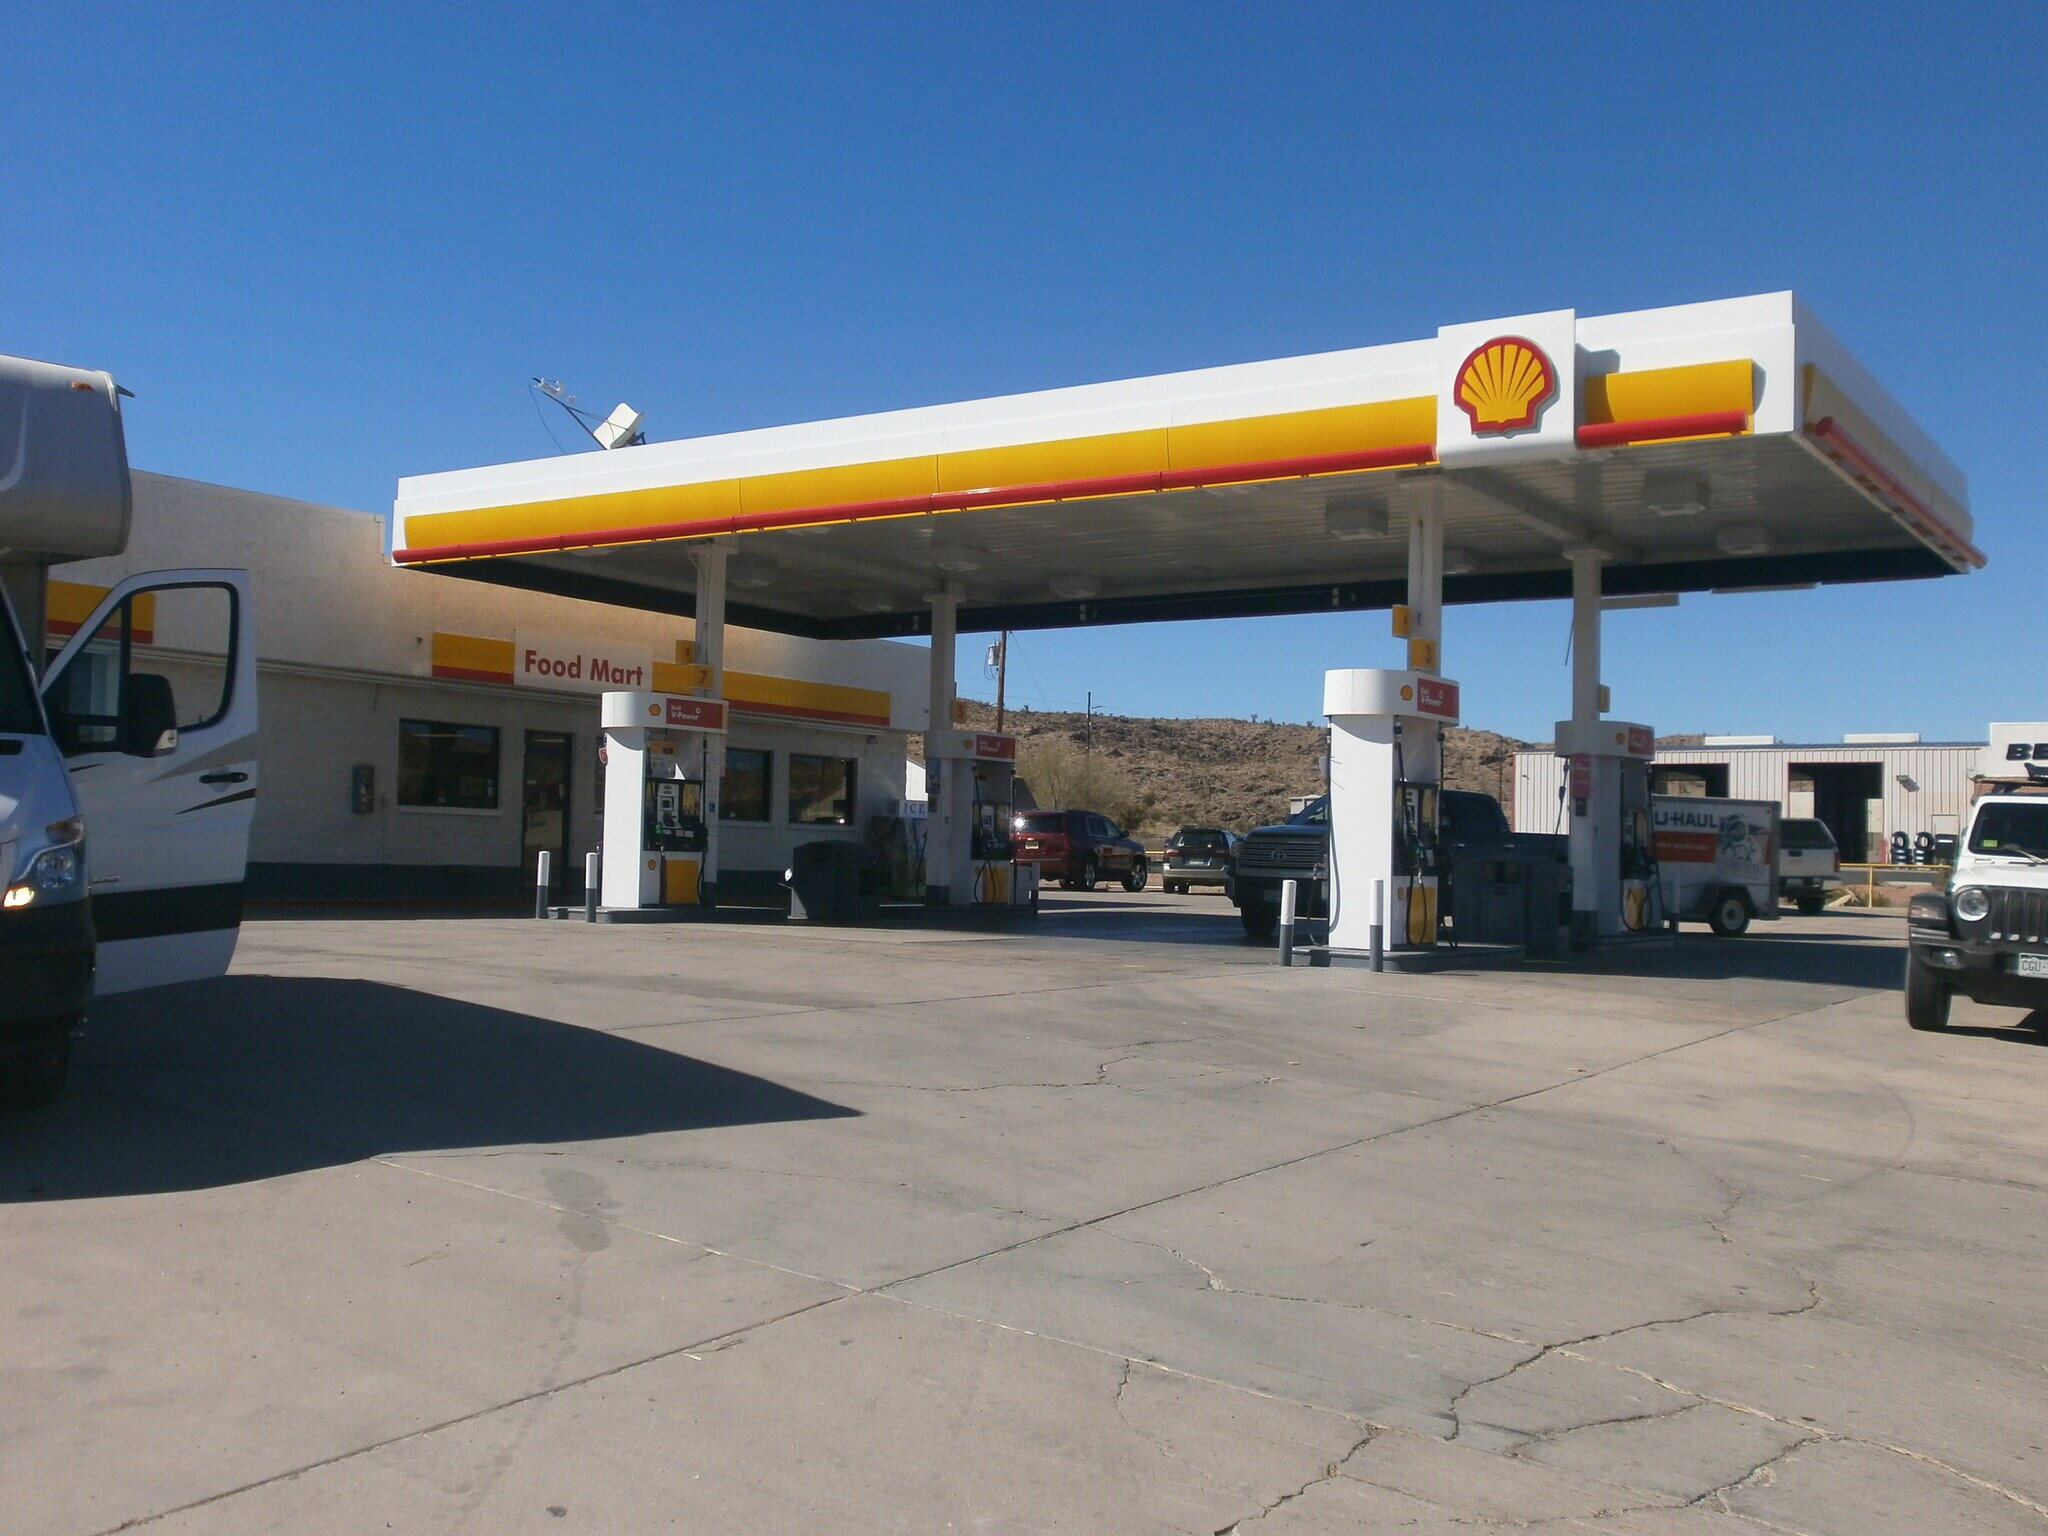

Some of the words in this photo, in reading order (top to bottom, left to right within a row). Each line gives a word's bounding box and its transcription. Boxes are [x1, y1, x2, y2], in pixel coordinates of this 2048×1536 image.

[1425, 646, 1432, 664] 3
[525, 649, 581, 679] Food
[590, 658, 643, 686] Mart
[700, 670, 707, 684] 7
[671, 711, 699, 720] V-Power
[904, 802, 925, 814] ICE
[1655, 811, 1718, 828] U-HAUL
